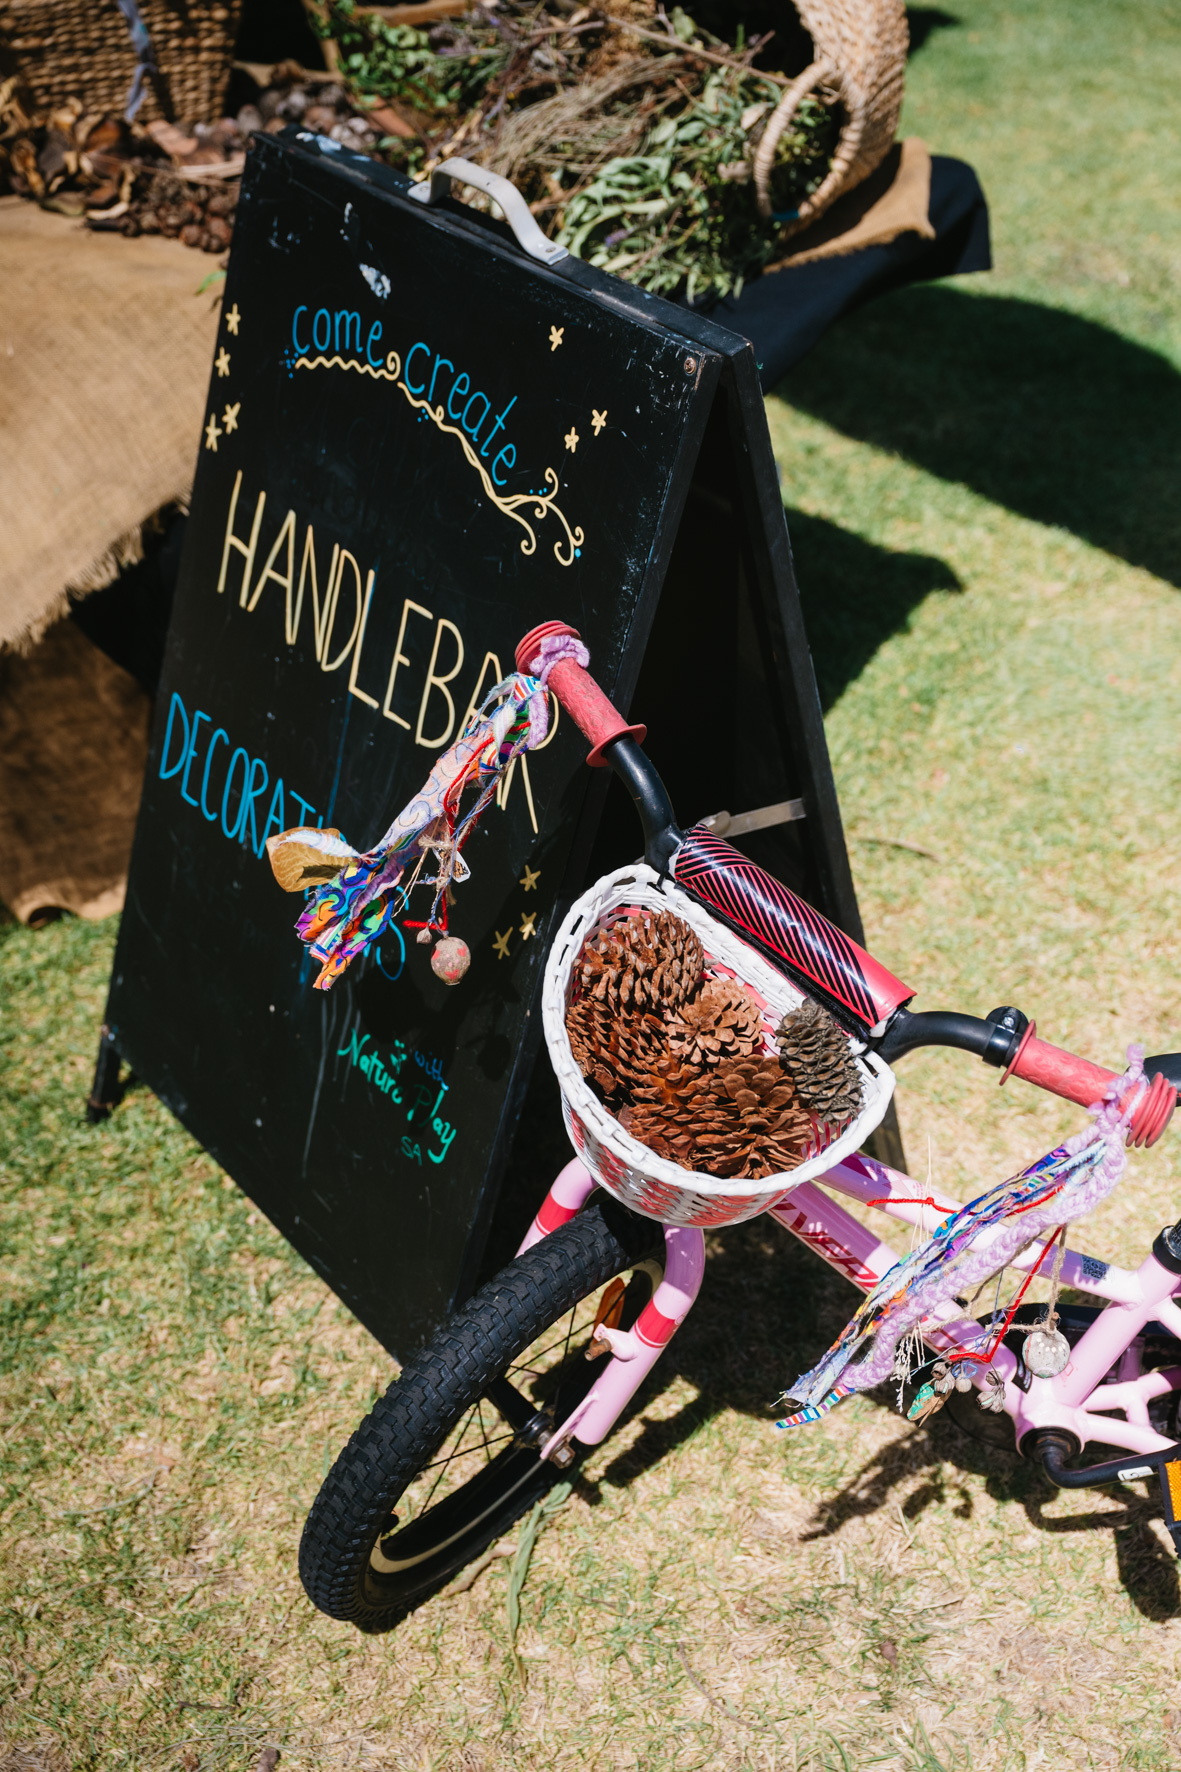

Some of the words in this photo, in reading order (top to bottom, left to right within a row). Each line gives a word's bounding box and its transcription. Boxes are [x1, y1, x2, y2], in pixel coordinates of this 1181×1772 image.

[291, 304, 384, 368] come
[404, 342, 518, 486] create
[337, 1027, 403, 1105] Nature
